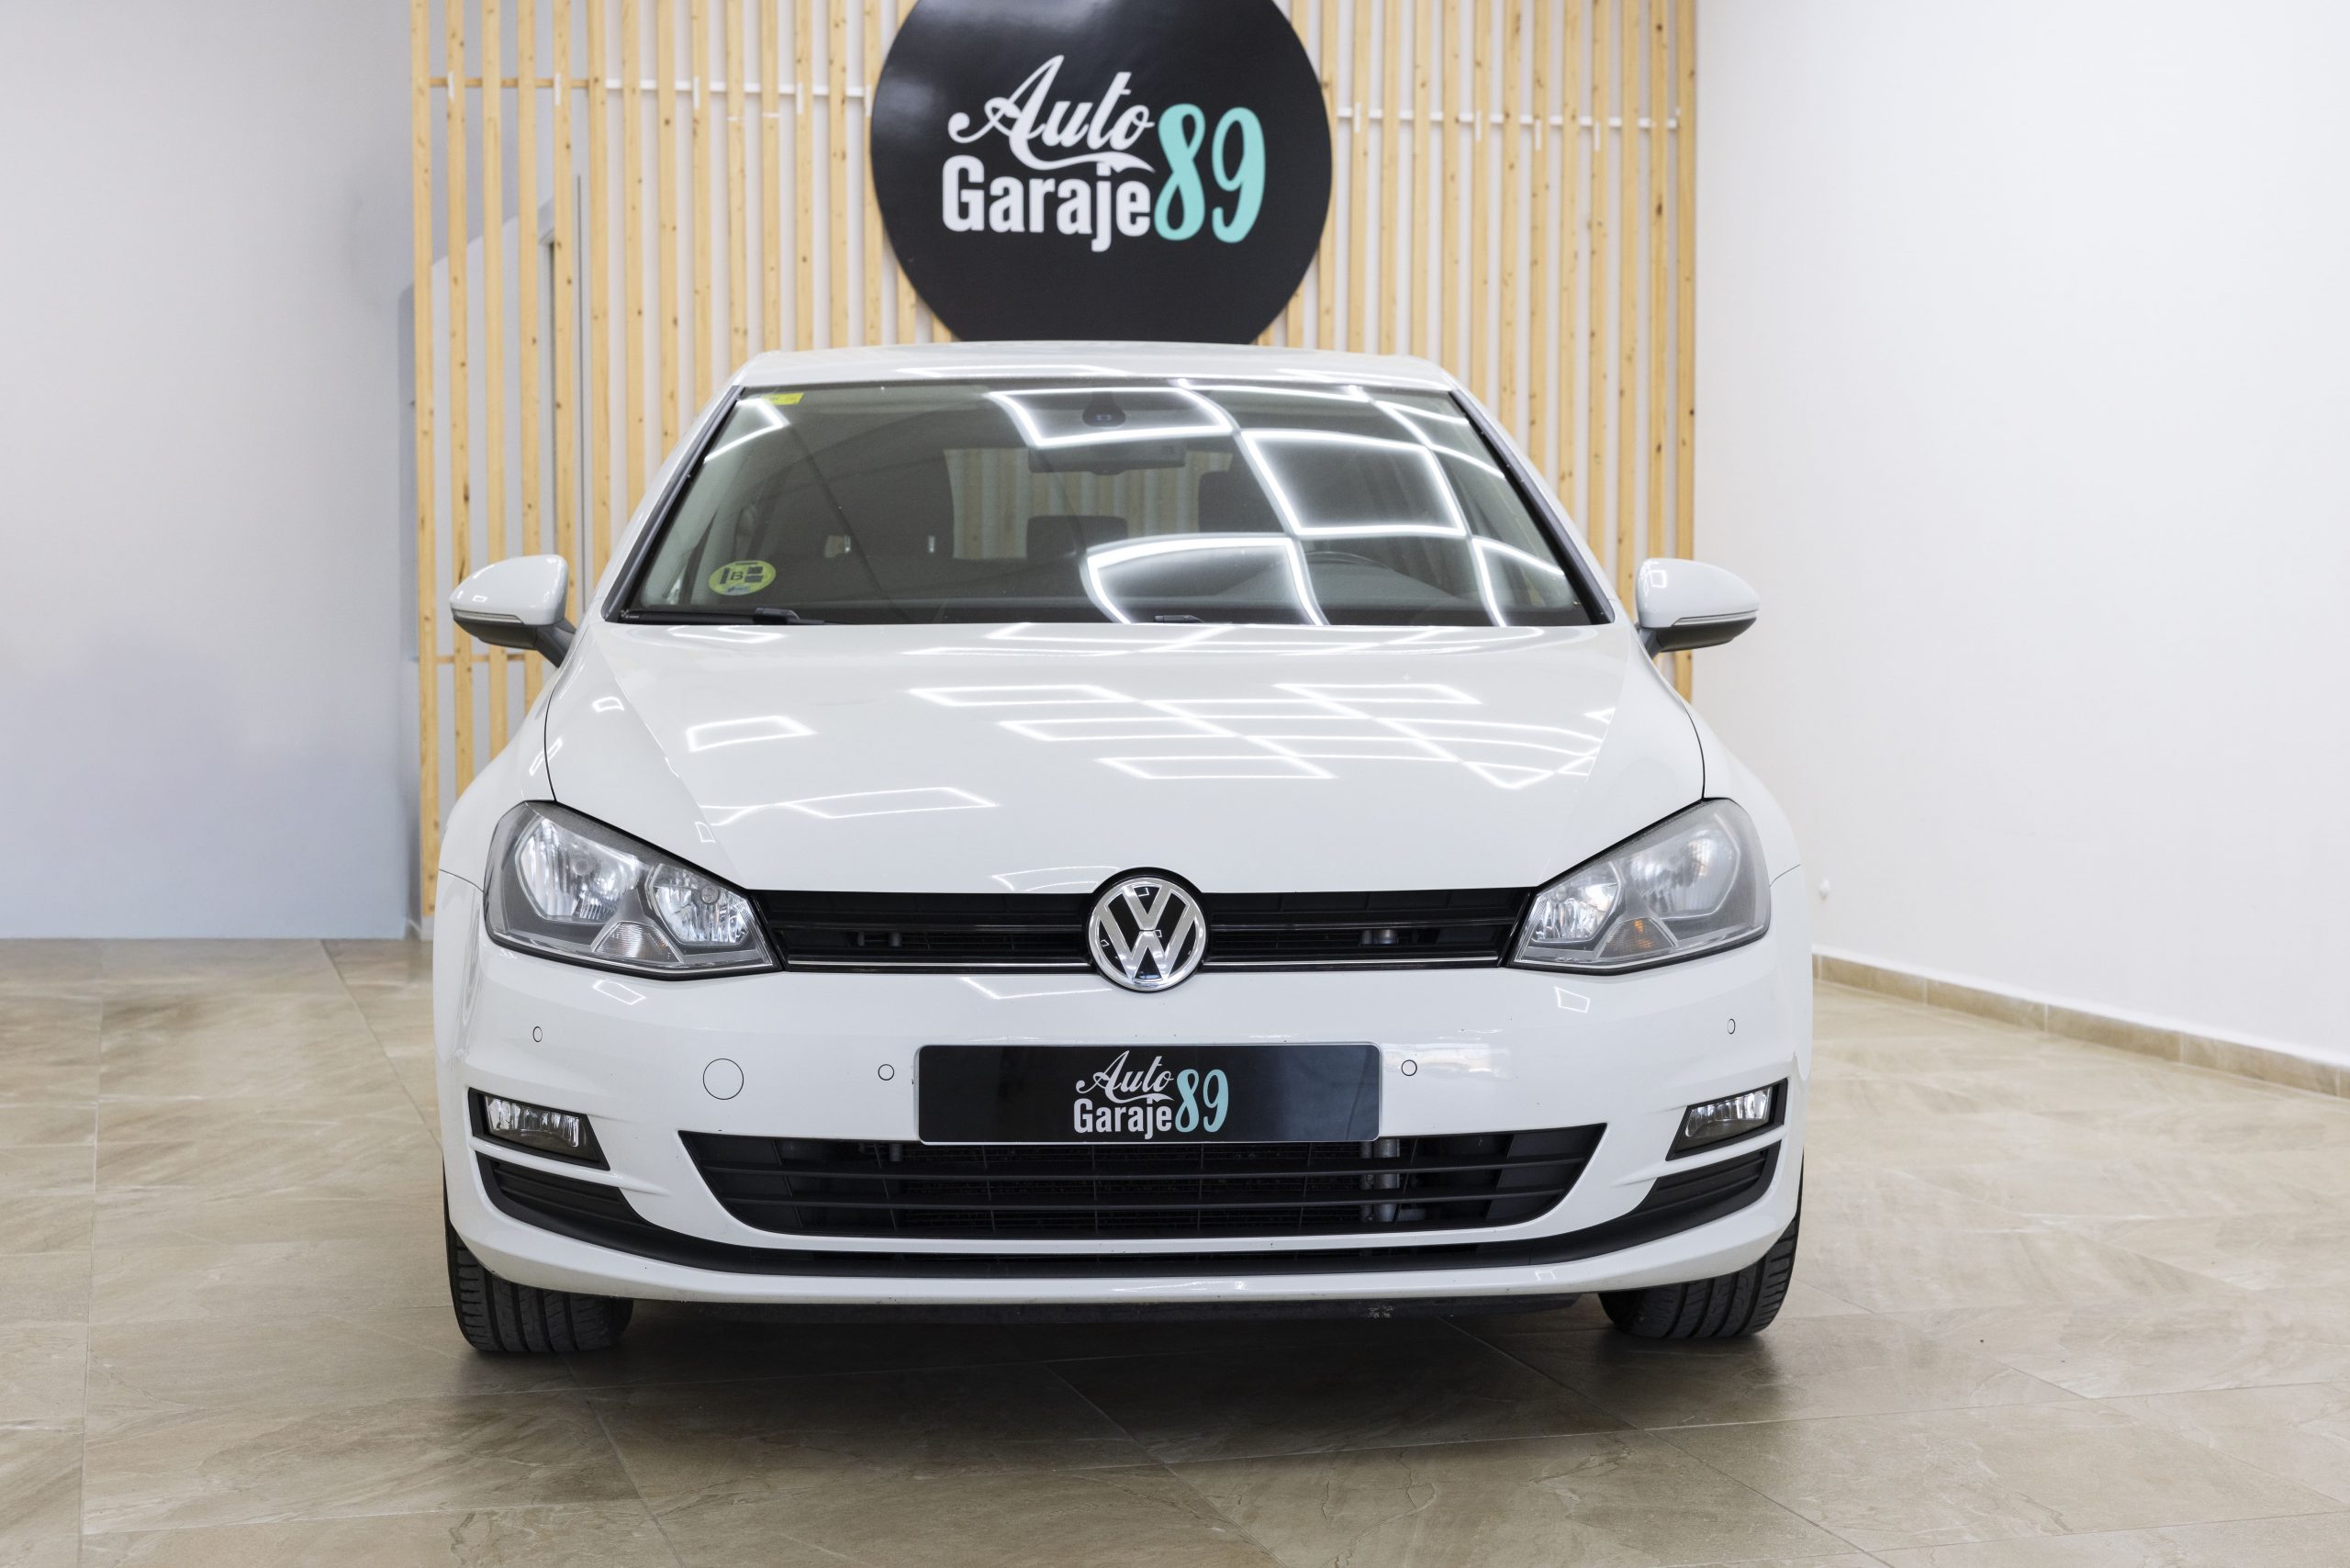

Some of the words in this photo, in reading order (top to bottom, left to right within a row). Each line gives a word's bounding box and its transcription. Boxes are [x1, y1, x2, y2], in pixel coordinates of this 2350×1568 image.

[947, 55, 1155, 173] Auto
[942, 154, 1151, 252] Garaje
[1154, 103, 1267, 243] 89
[1073, 1098, 1173, 1140] Garaje
[1174, 1069, 1229, 1133] 89
[1075, 1049, 1175, 1102] Auto
